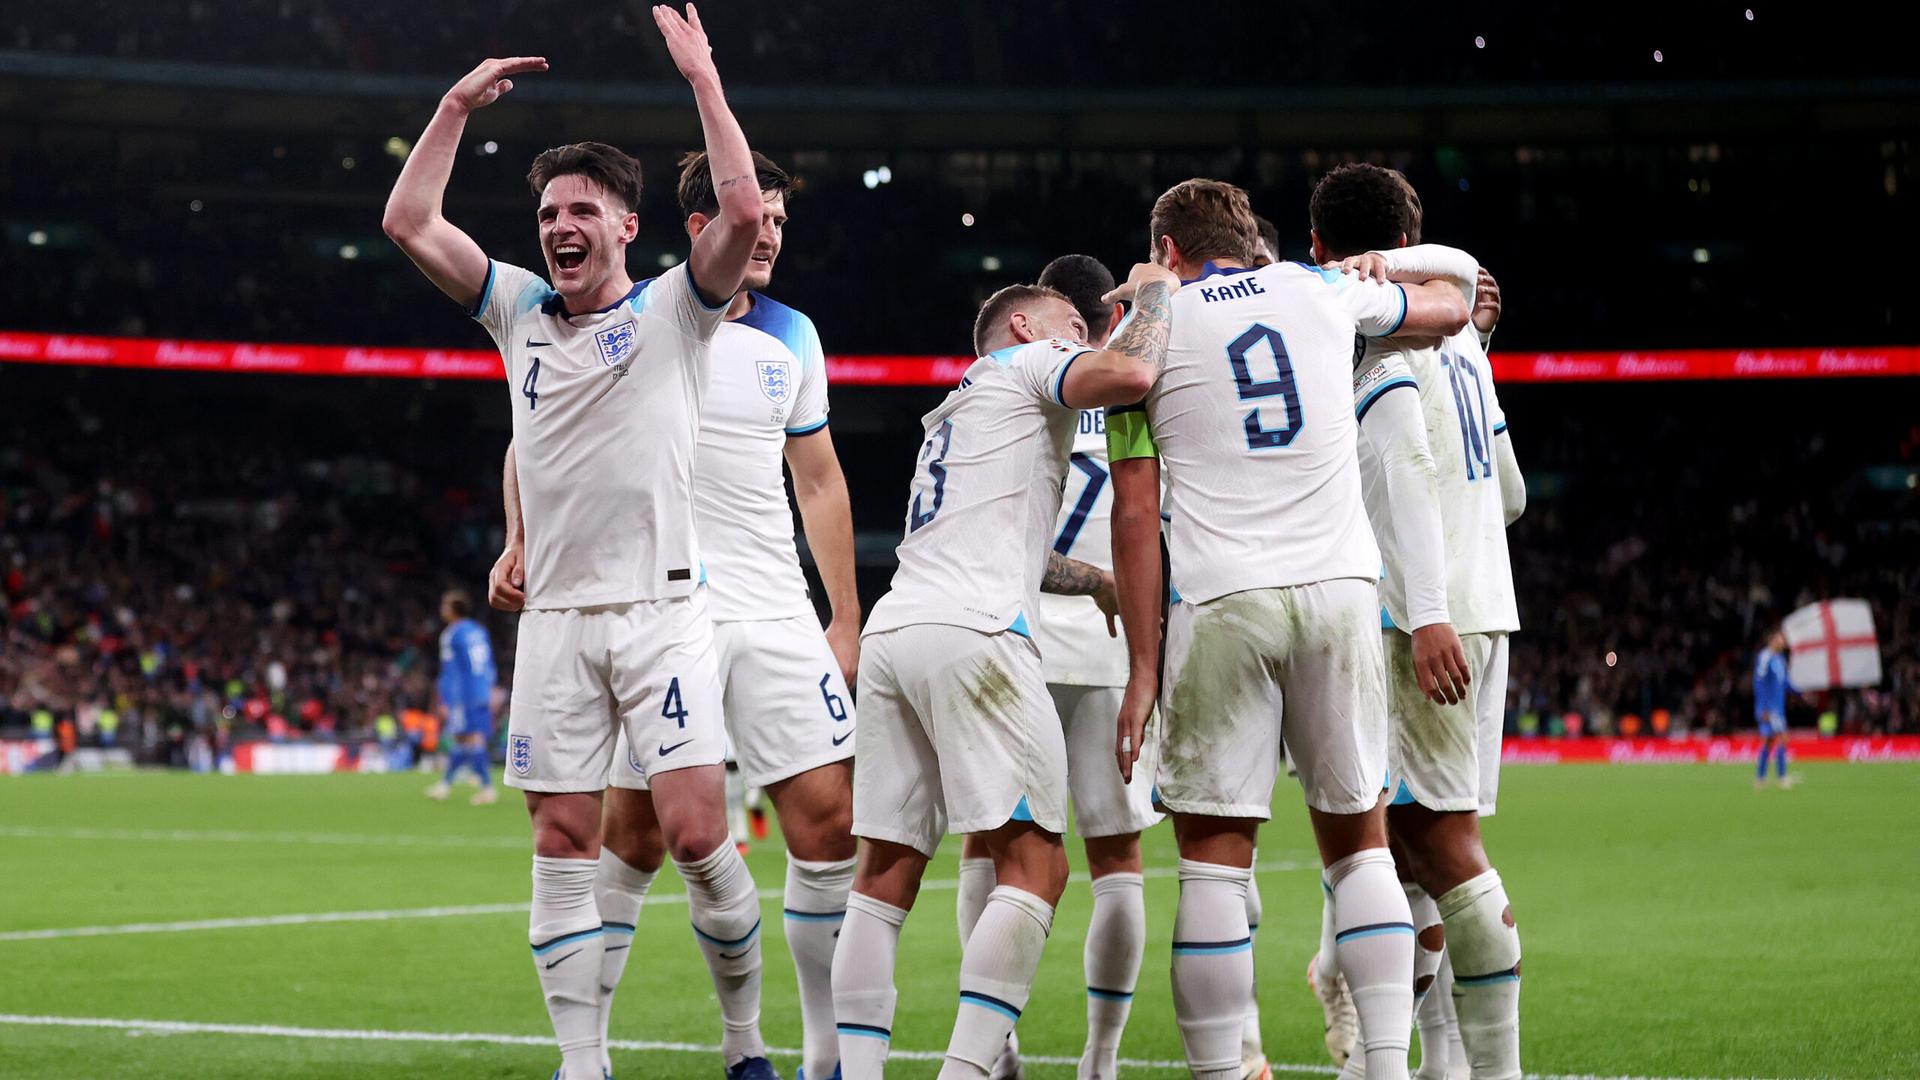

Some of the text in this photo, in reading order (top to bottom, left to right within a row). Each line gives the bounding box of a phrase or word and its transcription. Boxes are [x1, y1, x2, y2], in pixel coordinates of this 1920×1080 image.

[1200, 276, 1266, 304] KANE
[522, 357, 541, 411] 4
[1226, 321, 1304, 451] 9
[1353, 363, 1385, 389] NDATION
[1080, 410, 1105, 434] DE
[911, 418, 953, 534] 3
[1054, 452, 1110, 556] 7
[661, 677, 689, 729] 4
[819, 673, 847, 722] 6
